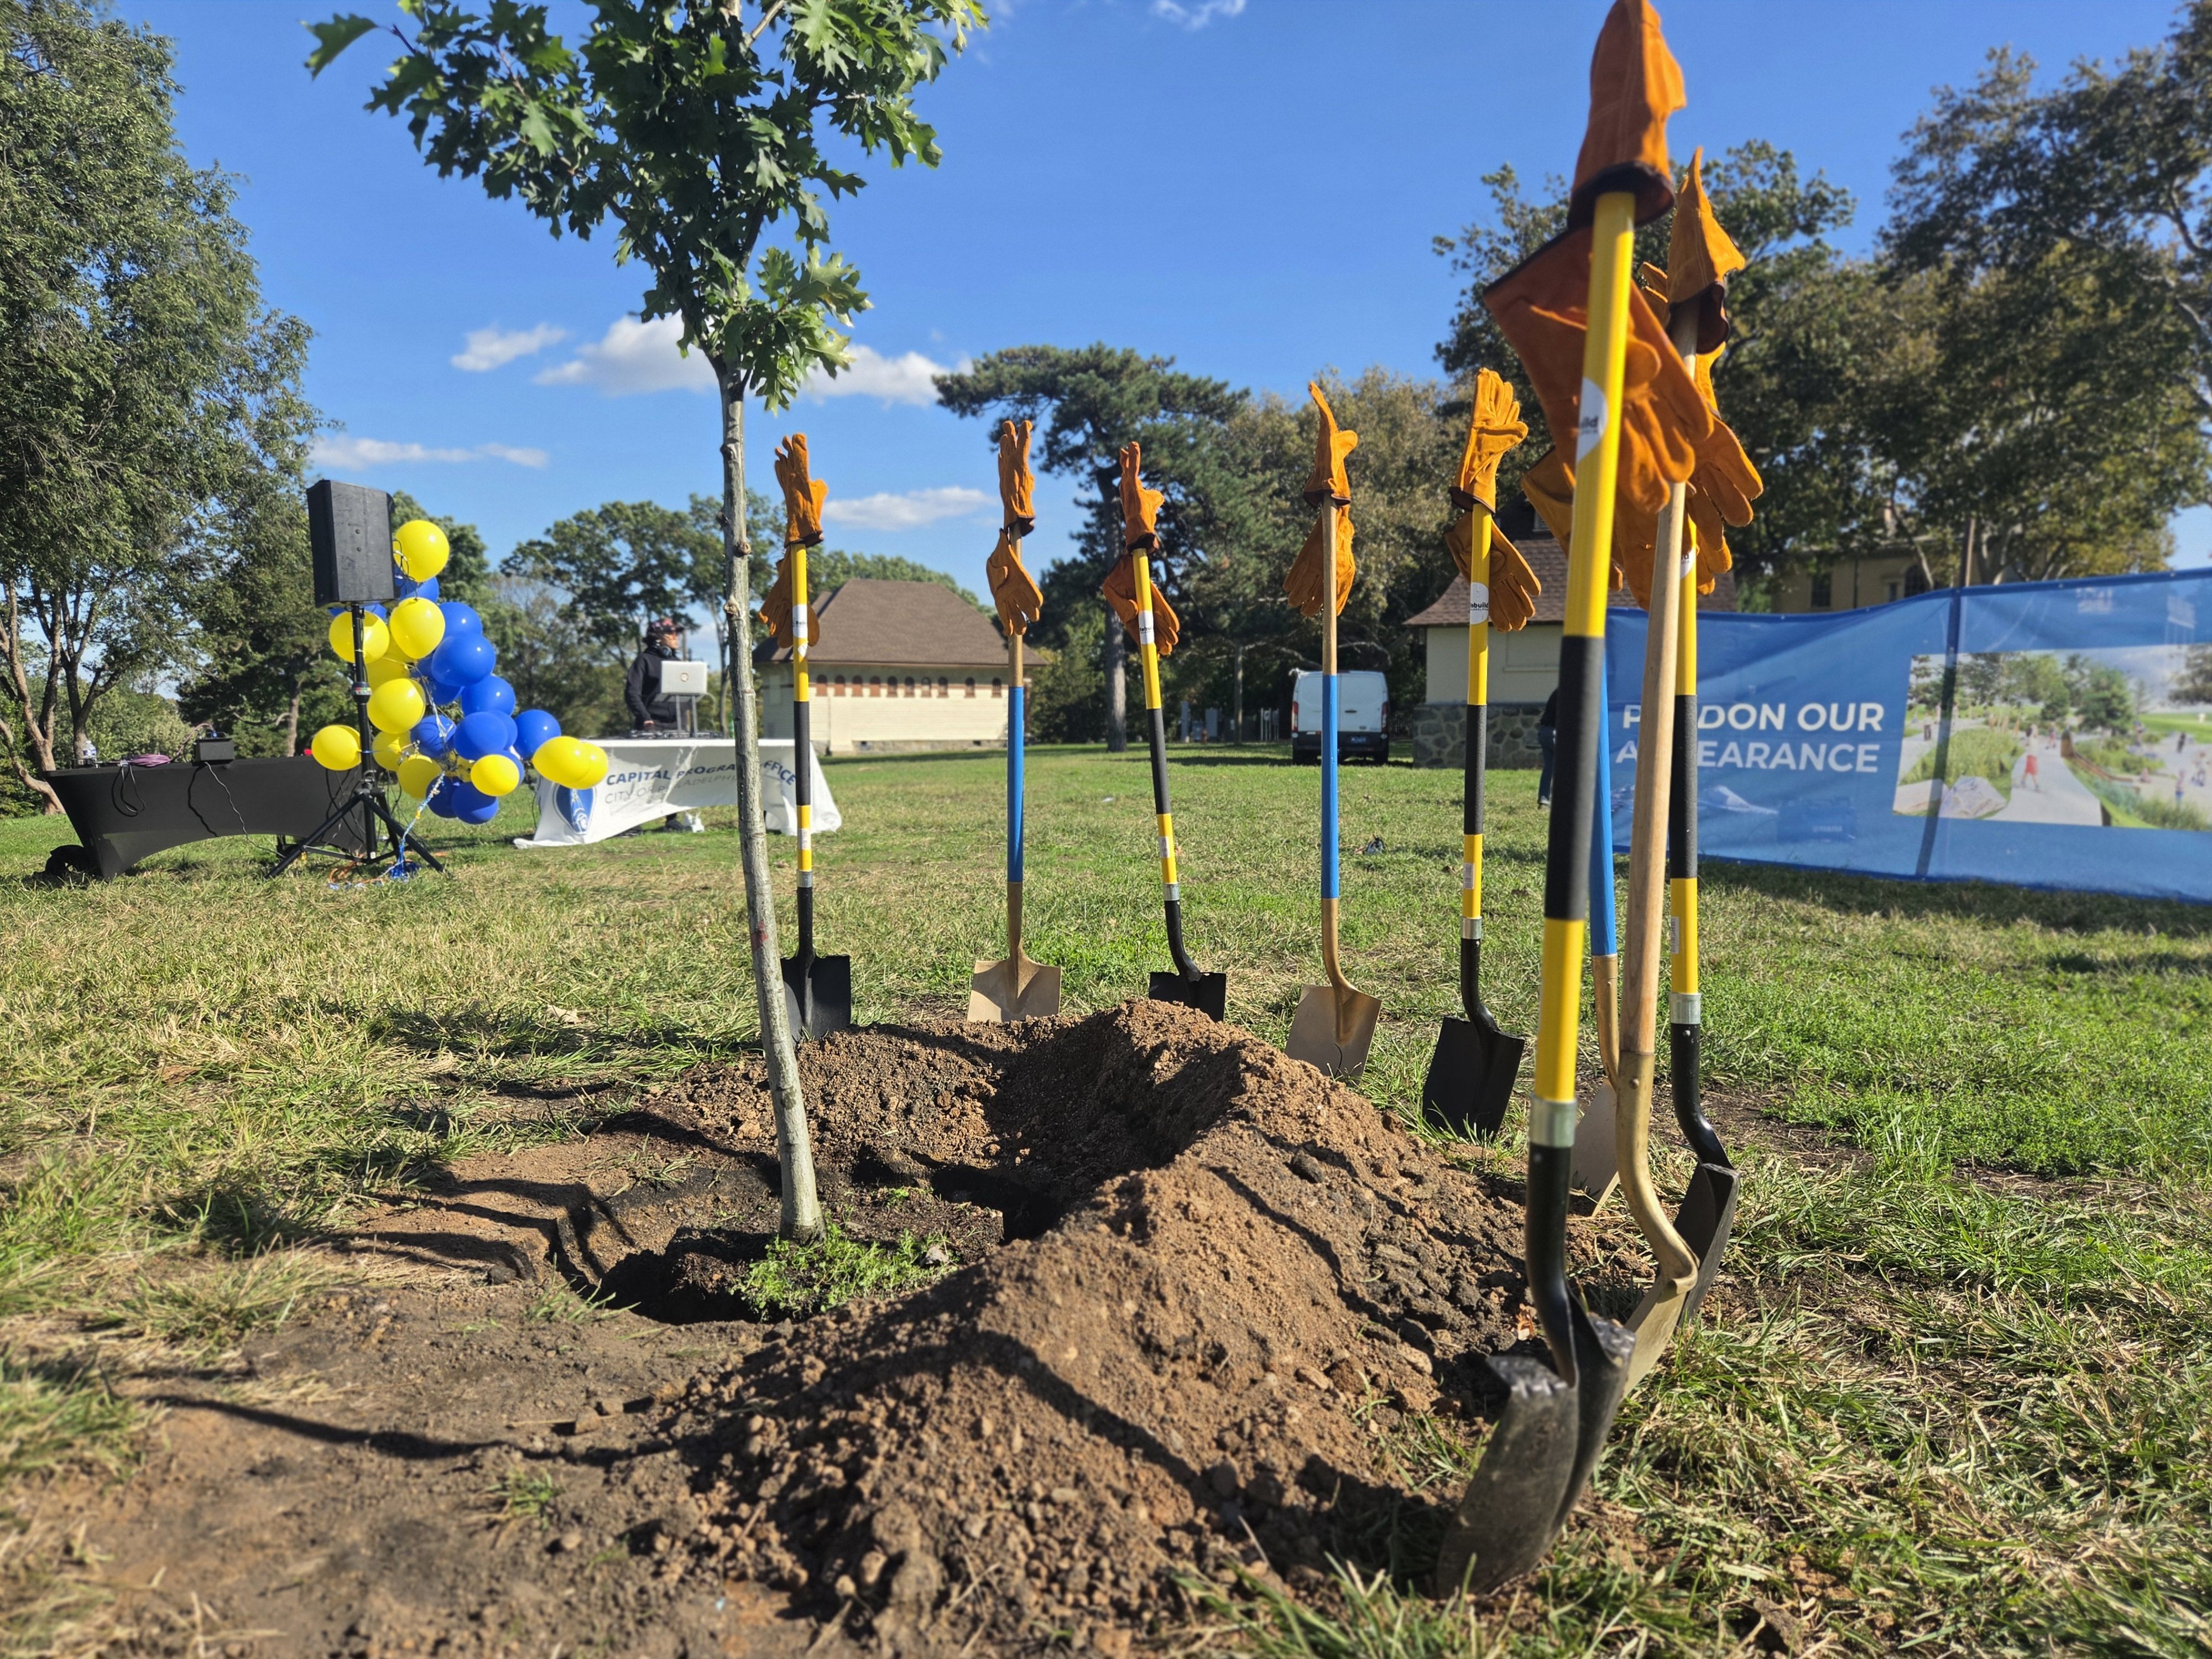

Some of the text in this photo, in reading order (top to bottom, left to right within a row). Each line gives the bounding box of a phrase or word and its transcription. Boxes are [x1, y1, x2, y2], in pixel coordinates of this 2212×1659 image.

[1623, 702, 1884, 731] PDON OUR
[1615, 740, 1880, 773] AEARANCE
[607, 760, 796, 785] CAPITAL PROGRA FFICE
[605, 791, 633, 804] CITY
